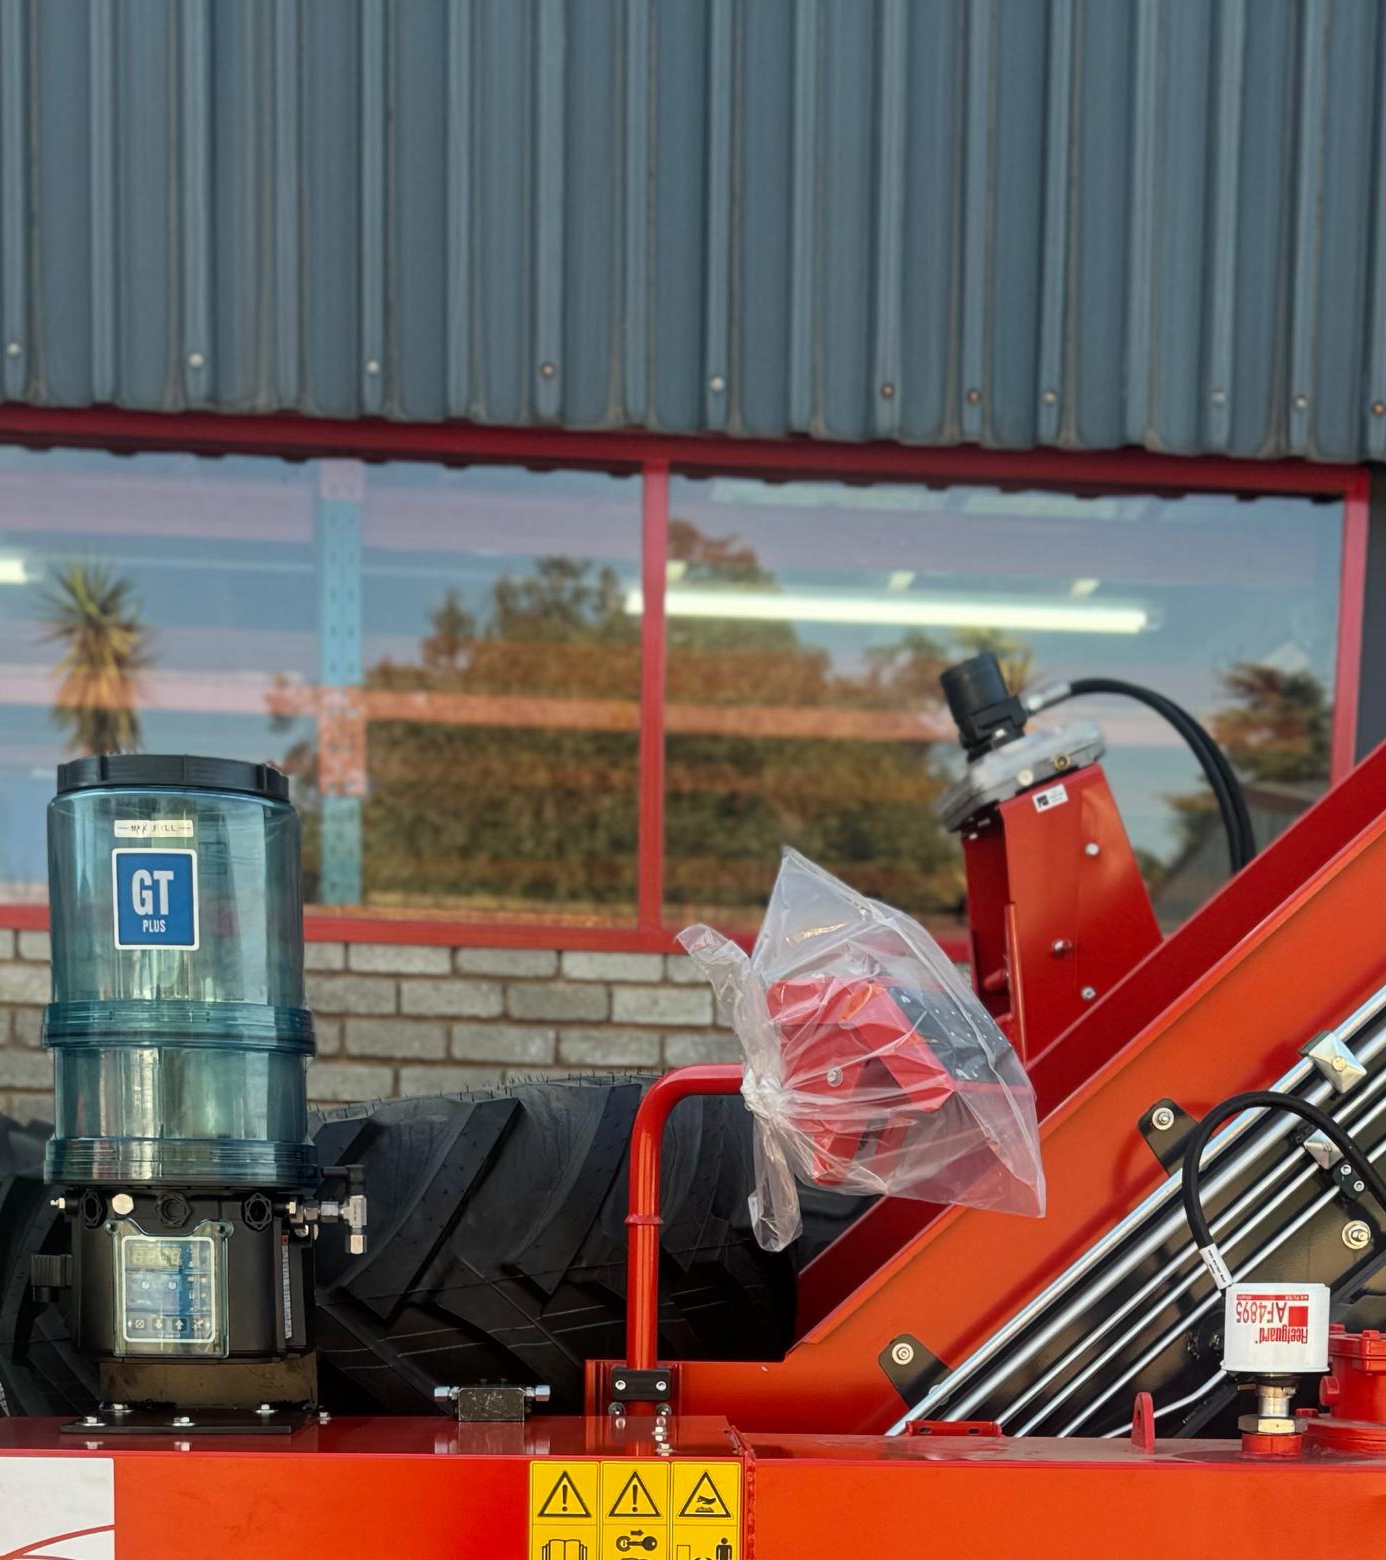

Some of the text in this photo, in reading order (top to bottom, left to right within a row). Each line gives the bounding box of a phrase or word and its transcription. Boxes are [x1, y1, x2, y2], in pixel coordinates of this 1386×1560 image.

[131, 869, 174, 916] GT
[142, 919, 166, 933] PLUS
[1236, 1301, 1287, 1323] AF4895
